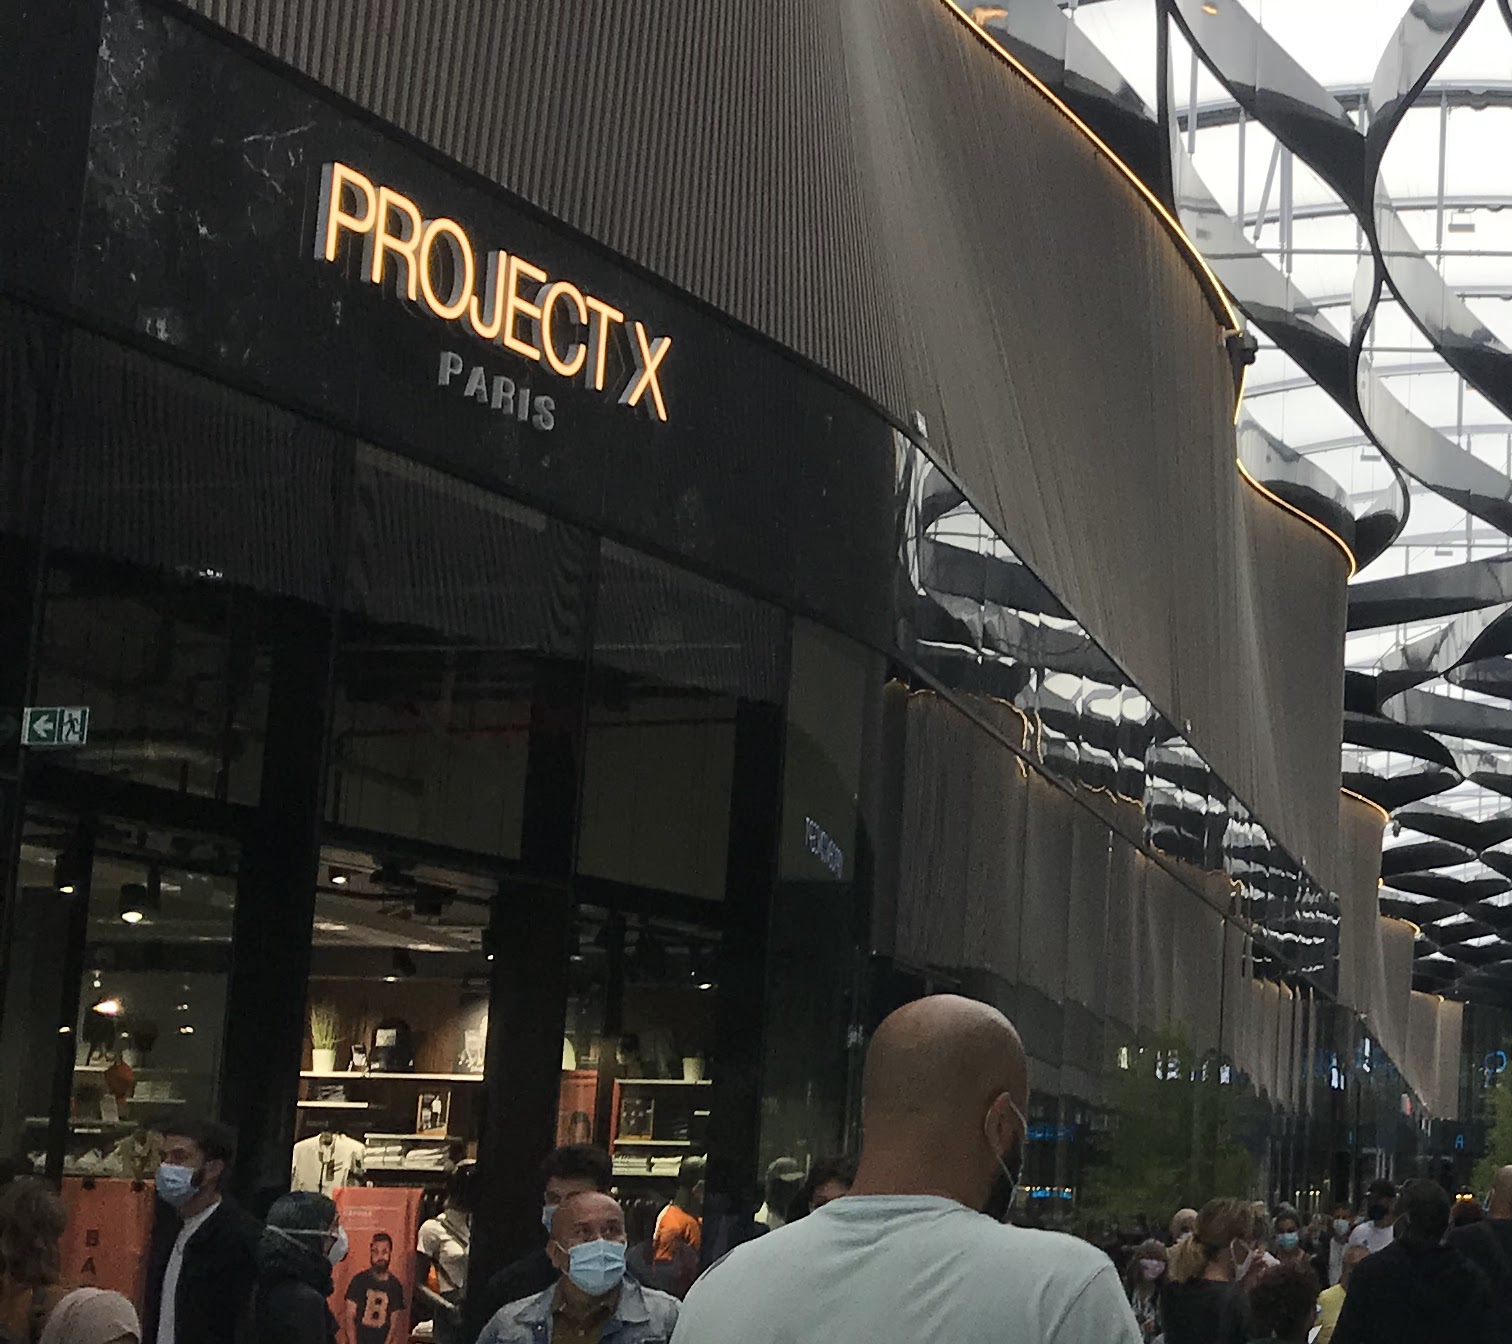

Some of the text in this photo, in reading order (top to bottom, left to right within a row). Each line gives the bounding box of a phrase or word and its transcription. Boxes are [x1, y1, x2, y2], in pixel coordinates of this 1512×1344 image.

[318, 161, 673, 422] PROJECT X
[437, 351, 557, 431] PARIS
